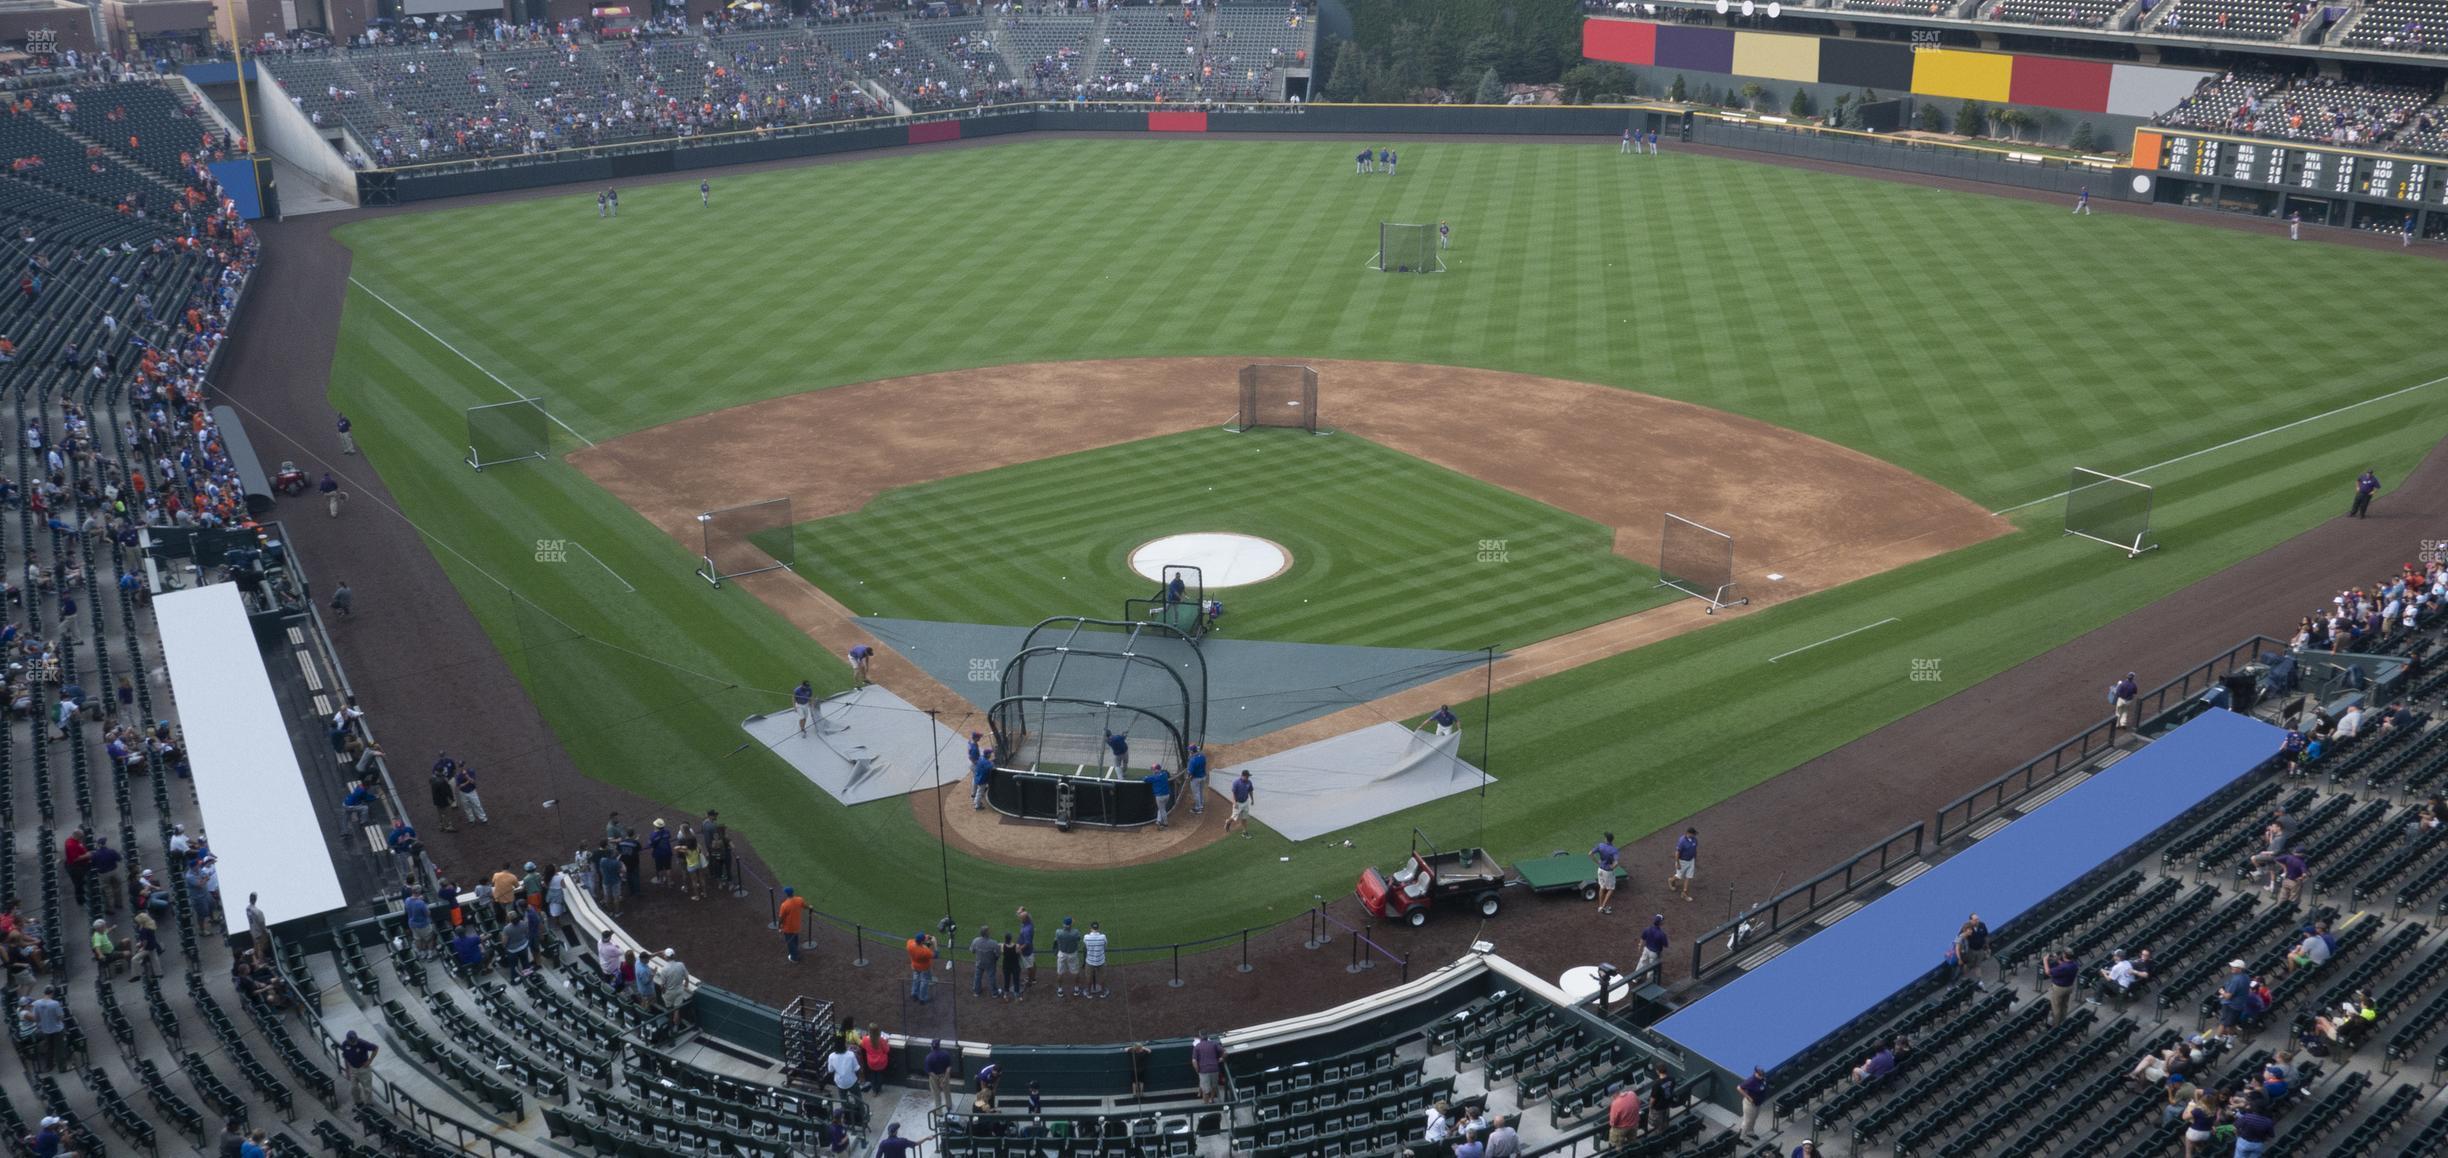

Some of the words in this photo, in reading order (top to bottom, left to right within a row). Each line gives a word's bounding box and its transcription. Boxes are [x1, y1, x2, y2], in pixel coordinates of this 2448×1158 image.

[2174, 138, 2187, 146] ATL
[2198, 140, 2205, 148] 7
[2172, 146, 2188, 155] CHC
[2204, 150, 2217, 158] 46
[2238, 144, 2254, 154] MIL
[2272, 148, 2284, 157] 41
[2172, 154, 2181, 163] SF
[2203, 158, 2216, 168] 70
[2238, 153, 2255, 162] WSH
[2270, 157, 2284, 166] 41
[2304, 152, 2320, 161] PHI
[2340, 156, 2354, 165] 34
[2170, 164, 2182, 172] PIT
[2202, 167, 2214, 176] 35
[2236, 162, 2250, 172] ARI
[2269, 166, 2282, 176] 58
[2304, 161, 2321, 170] MIA
[2338, 166, 2352, 174] 60
[2376, 160, 2392, 170] LAD
[2412, 164, 2425, 173] 21
[2234, 171, 2250, 180] CIN
[2268, 175, 2280, 184] 28
[2302, 170, 2316, 180] STL
[2338, 174, 2350, 184] 18
[2373, 169, 2392, 178] HOU
[2410, 173, 2424, 182] 26
[2301, 179, 2312, 188] SD
[2336, 184, 2350, 192] 22
[2372, 178, 2386, 188] CLE
[2400, 182, 2406, 190] 2
[2408, 183, 2422, 192] 31
[2406, 192, 2420, 201] 40
